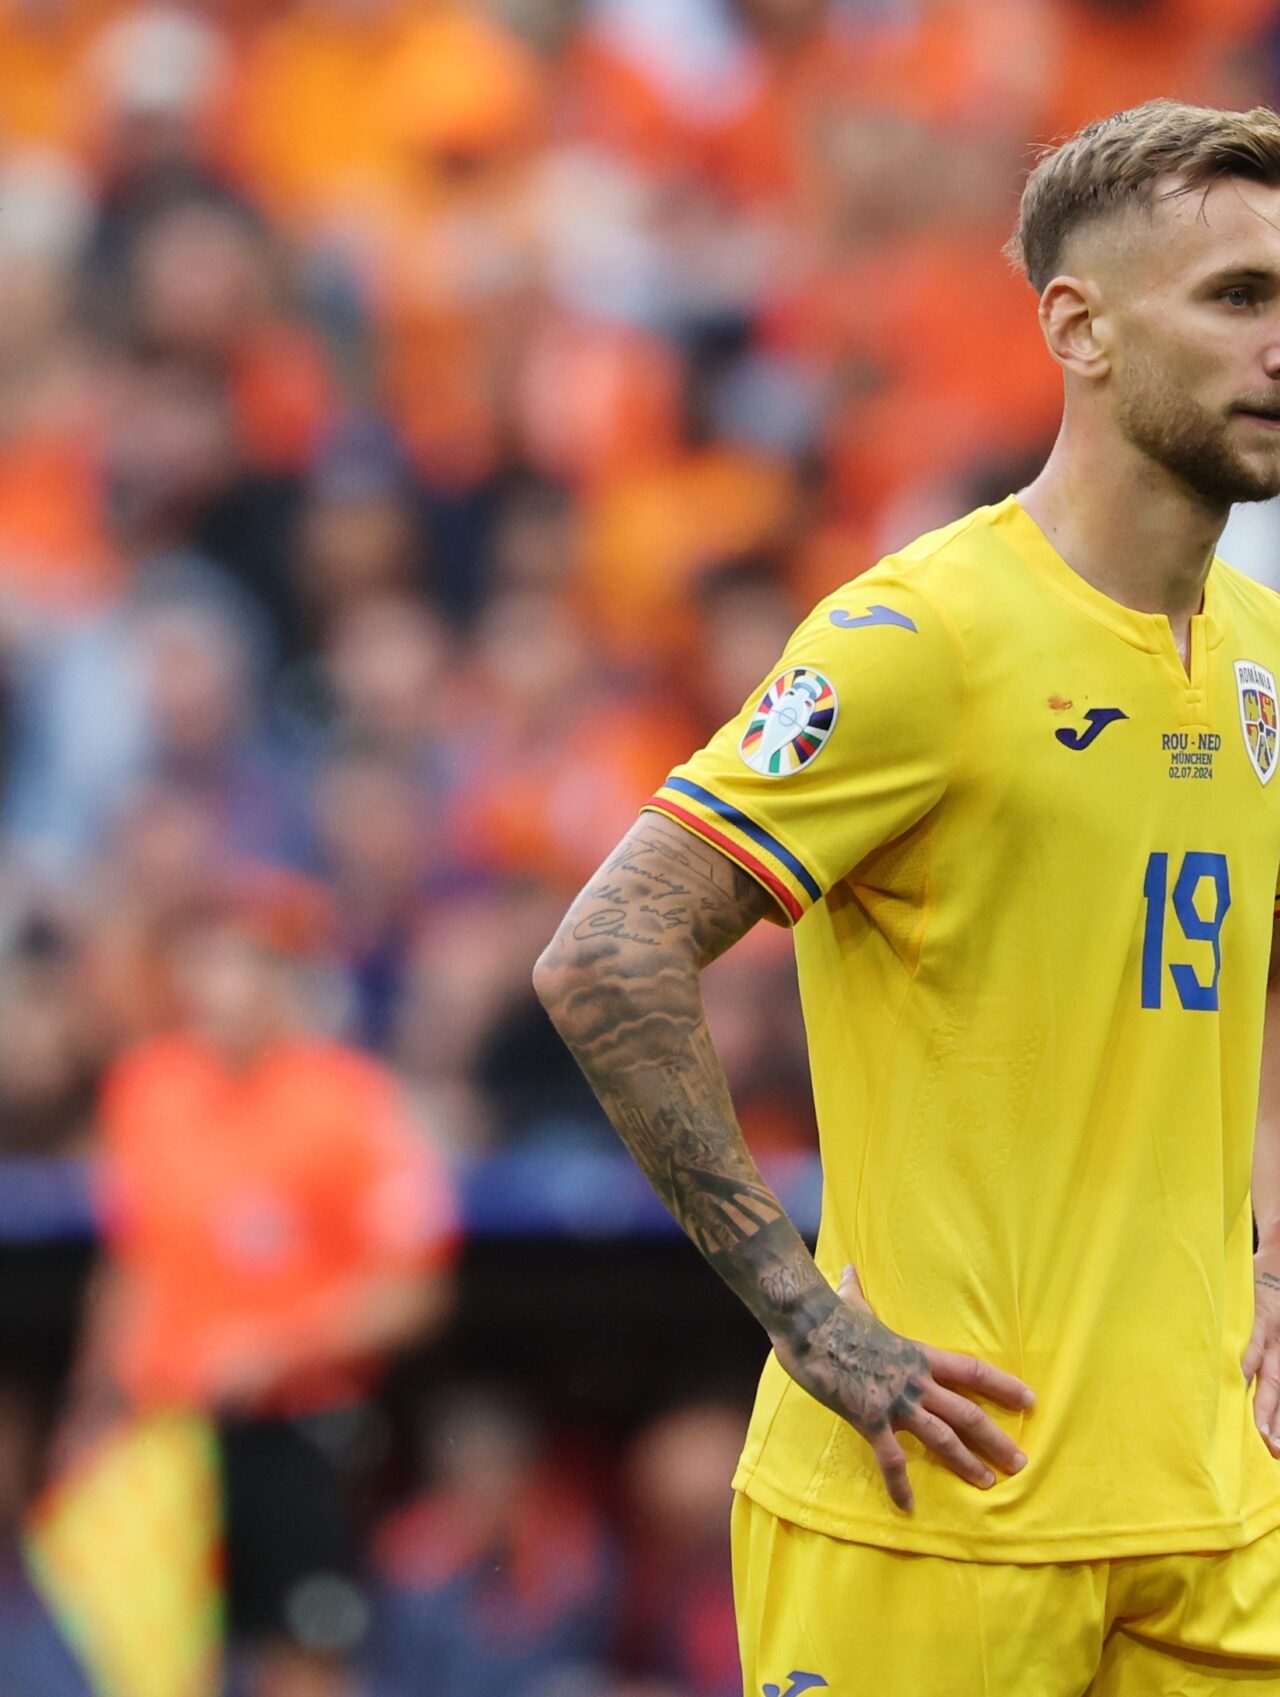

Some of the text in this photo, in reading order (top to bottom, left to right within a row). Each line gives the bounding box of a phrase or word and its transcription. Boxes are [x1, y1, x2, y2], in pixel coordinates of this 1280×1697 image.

[1162, 733, 1188, 750] ROU
[1198, 733, 1221, 751] NED
[1171, 751, 1213, 765] MÜNCHEN
[1169, 766, 1213, 780] 02.07.2024
[1141, 851, 1232, 1012] 19
